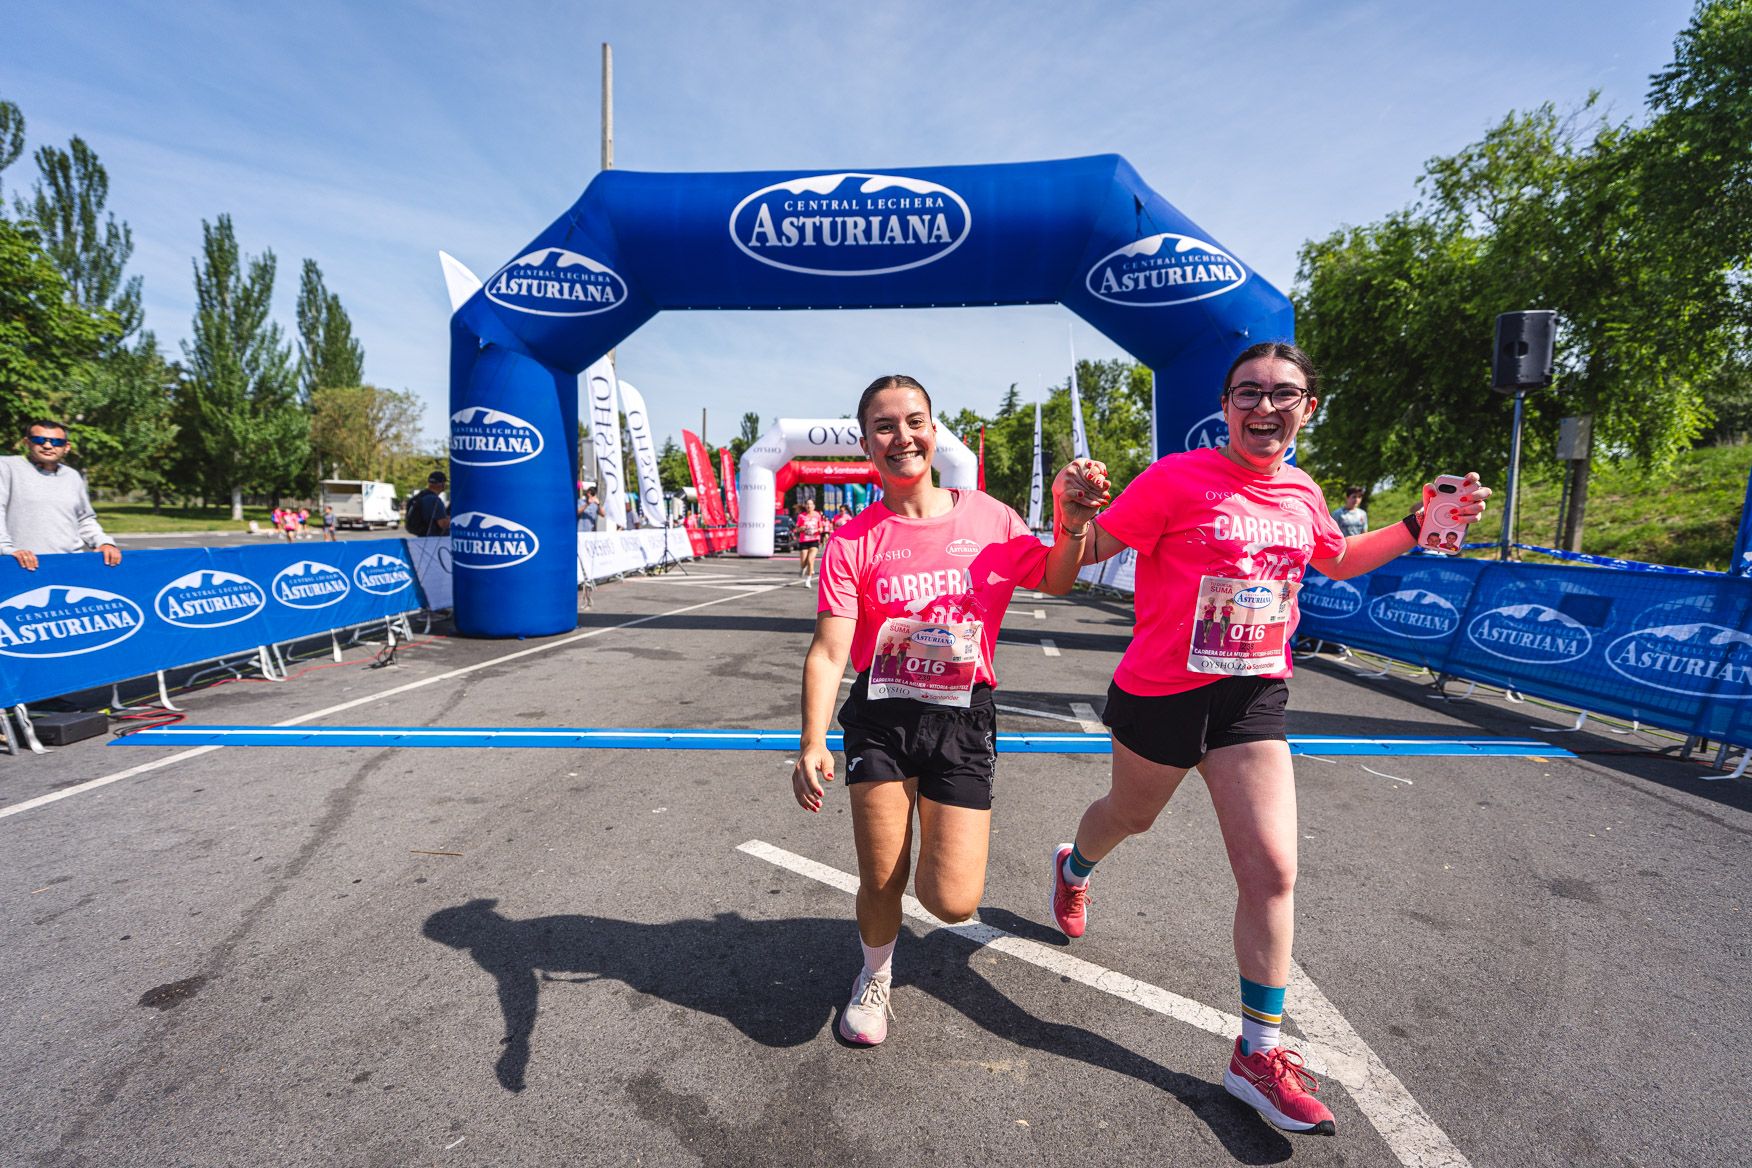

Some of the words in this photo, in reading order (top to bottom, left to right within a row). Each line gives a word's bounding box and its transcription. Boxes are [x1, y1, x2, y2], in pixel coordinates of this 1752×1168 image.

[784, 199, 859, 211] CENTRAL
[867, 197, 944, 209] LECHERA
[749, 203, 952, 247] ASTURIANA
[1123, 258, 1176, 270] CENTRAL
[513, 269, 556, 278] CENTRAL
[560, 271, 611, 283] LECHERA
[1100, 264, 1239, 294] ASTURIANA
[490, 272, 616, 302] ASTURIANA
[486, 427, 530, 436] LECHERA
[808, 426, 858, 446] OYS
[451, 435, 534, 453] STURIANA
[834, 466, 869, 474] Santander
[483, 531, 526, 540] LECHERA
[1214, 515, 1310, 551] CARRERA
[453, 538, 529, 556] STURIANA
[870, 548, 912, 565] OYSHO
[179, 590, 216, 599] CENTRAL
[281, 579, 347, 600] ASTURIANA
[876, 567, 974, 605] CARRERA
[1210, 586, 1233, 594] SUMA
[167, 591, 261, 619] ASTURIANA
[1300, 592, 1355, 612] STURIANA
[15, 608, 71, 622] CENTRAL
[74, 602, 124, 614] LECHERA
[1374, 601, 1450, 632] ASTURIANA
[0, 610, 137, 648] ASTURIANA
[889, 625, 910, 634] SUMA
[1230, 624, 1266, 641] 016
[1474, 618, 1578, 655] ASTURIANA
[914, 633, 953, 645] ASTURIANA
[1194, 648, 1218, 656] CARRERA
[906, 657, 946, 675] 016
[1201, 660, 1235, 669] OYSHO
[1252, 662, 1275, 670] Santander
[878, 686, 911, 696] OYSHO
